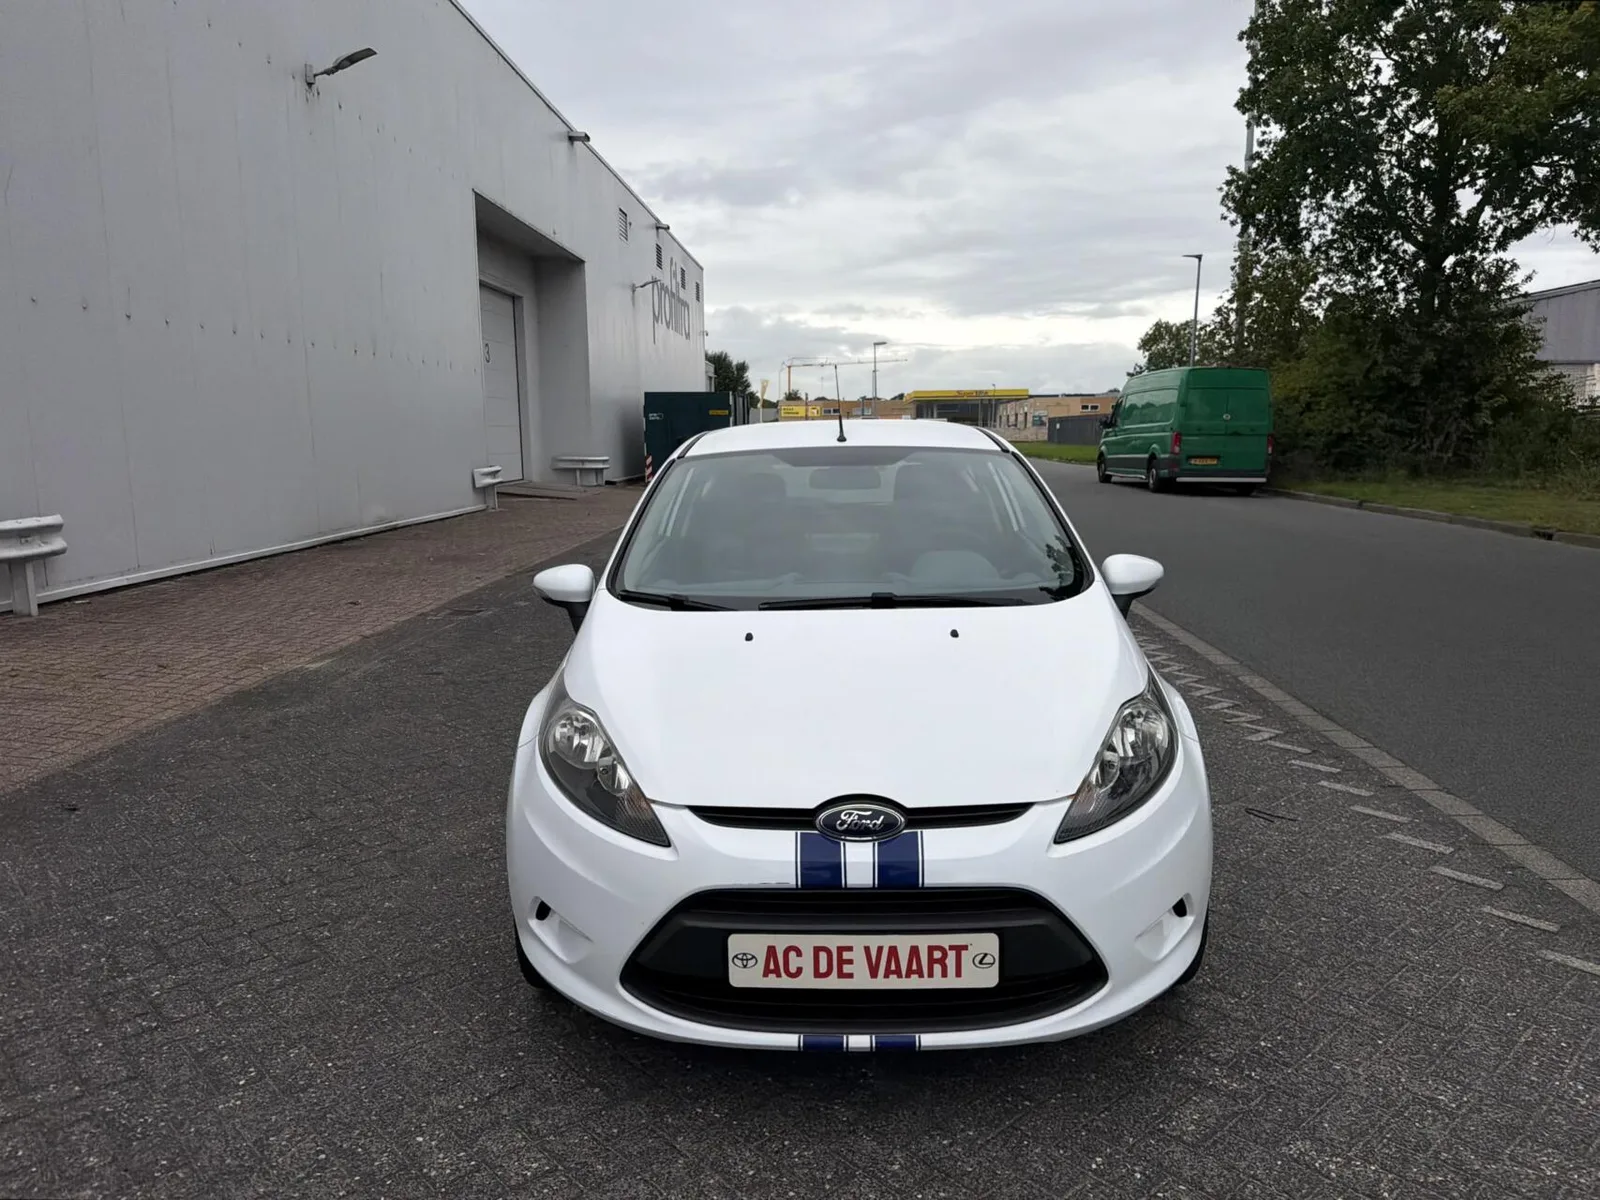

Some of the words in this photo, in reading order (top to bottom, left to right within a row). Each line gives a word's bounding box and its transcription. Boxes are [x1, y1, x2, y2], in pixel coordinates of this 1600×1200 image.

[485, 343, 491, 364] 3
[836, 809, 884, 830] Ford
[762, 945, 803, 979] AC
[813, 945, 854, 979] DE
[863, 944, 969, 979] VAART
